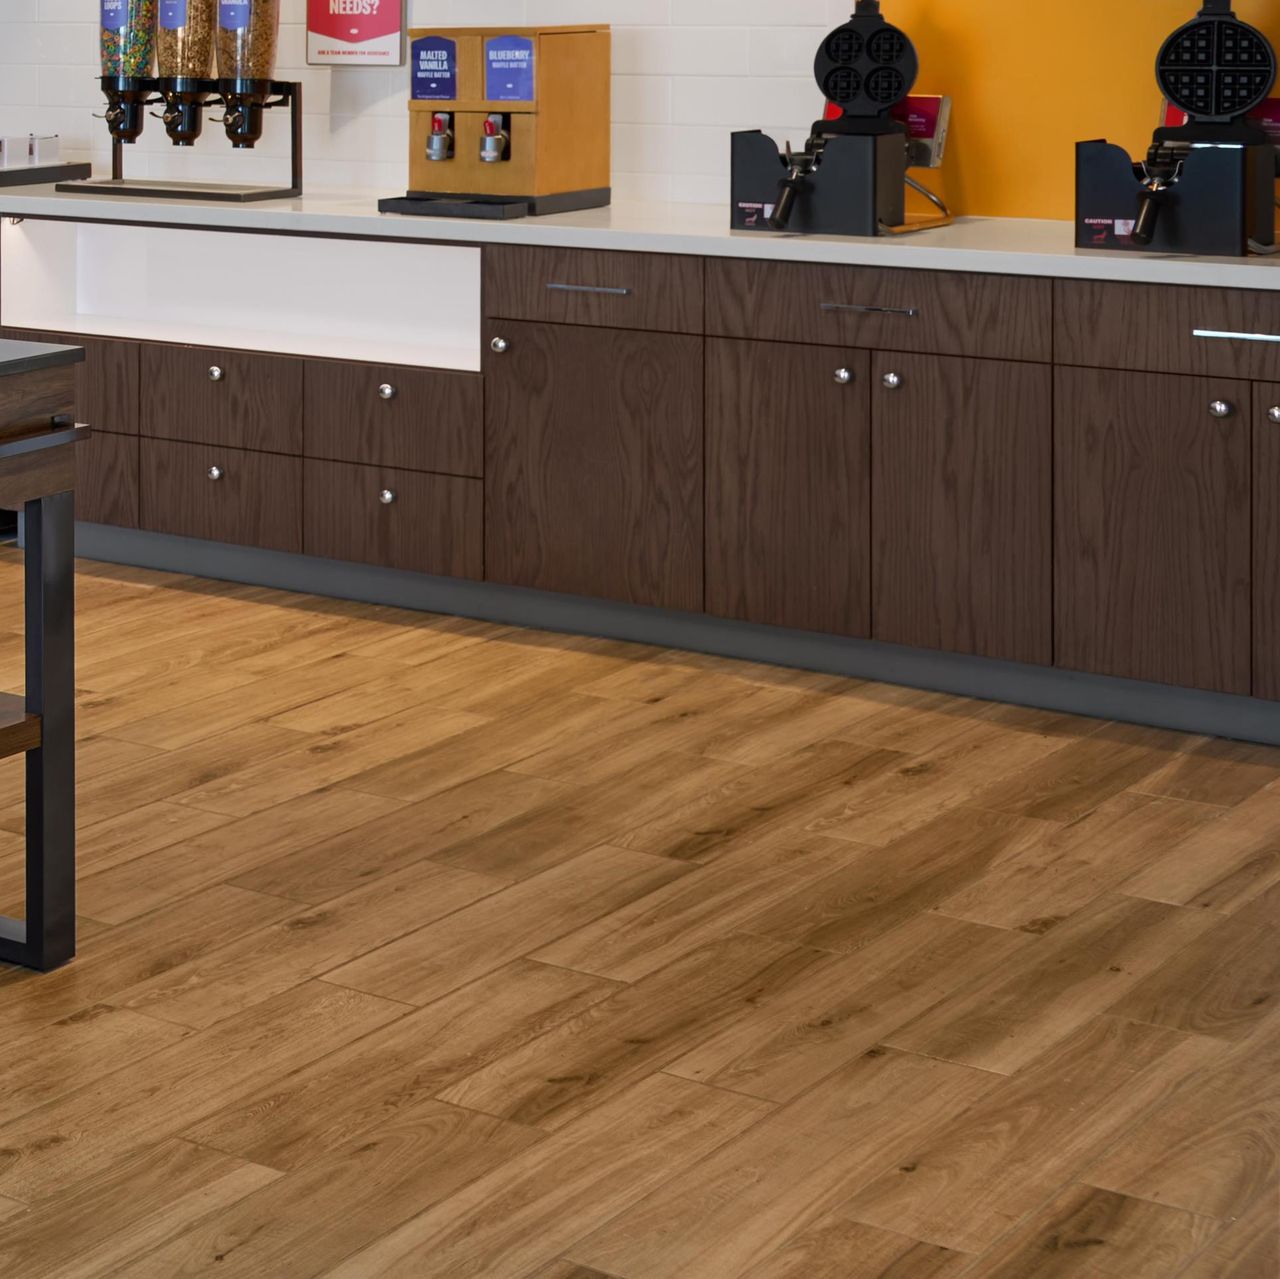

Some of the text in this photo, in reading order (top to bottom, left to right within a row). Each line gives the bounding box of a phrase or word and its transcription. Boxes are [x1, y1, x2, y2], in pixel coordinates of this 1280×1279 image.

[420, 50, 448, 60] MALTED
[489, 49, 530, 61] BLUEBERRY
[419, 60, 449, 70] VANILLA
